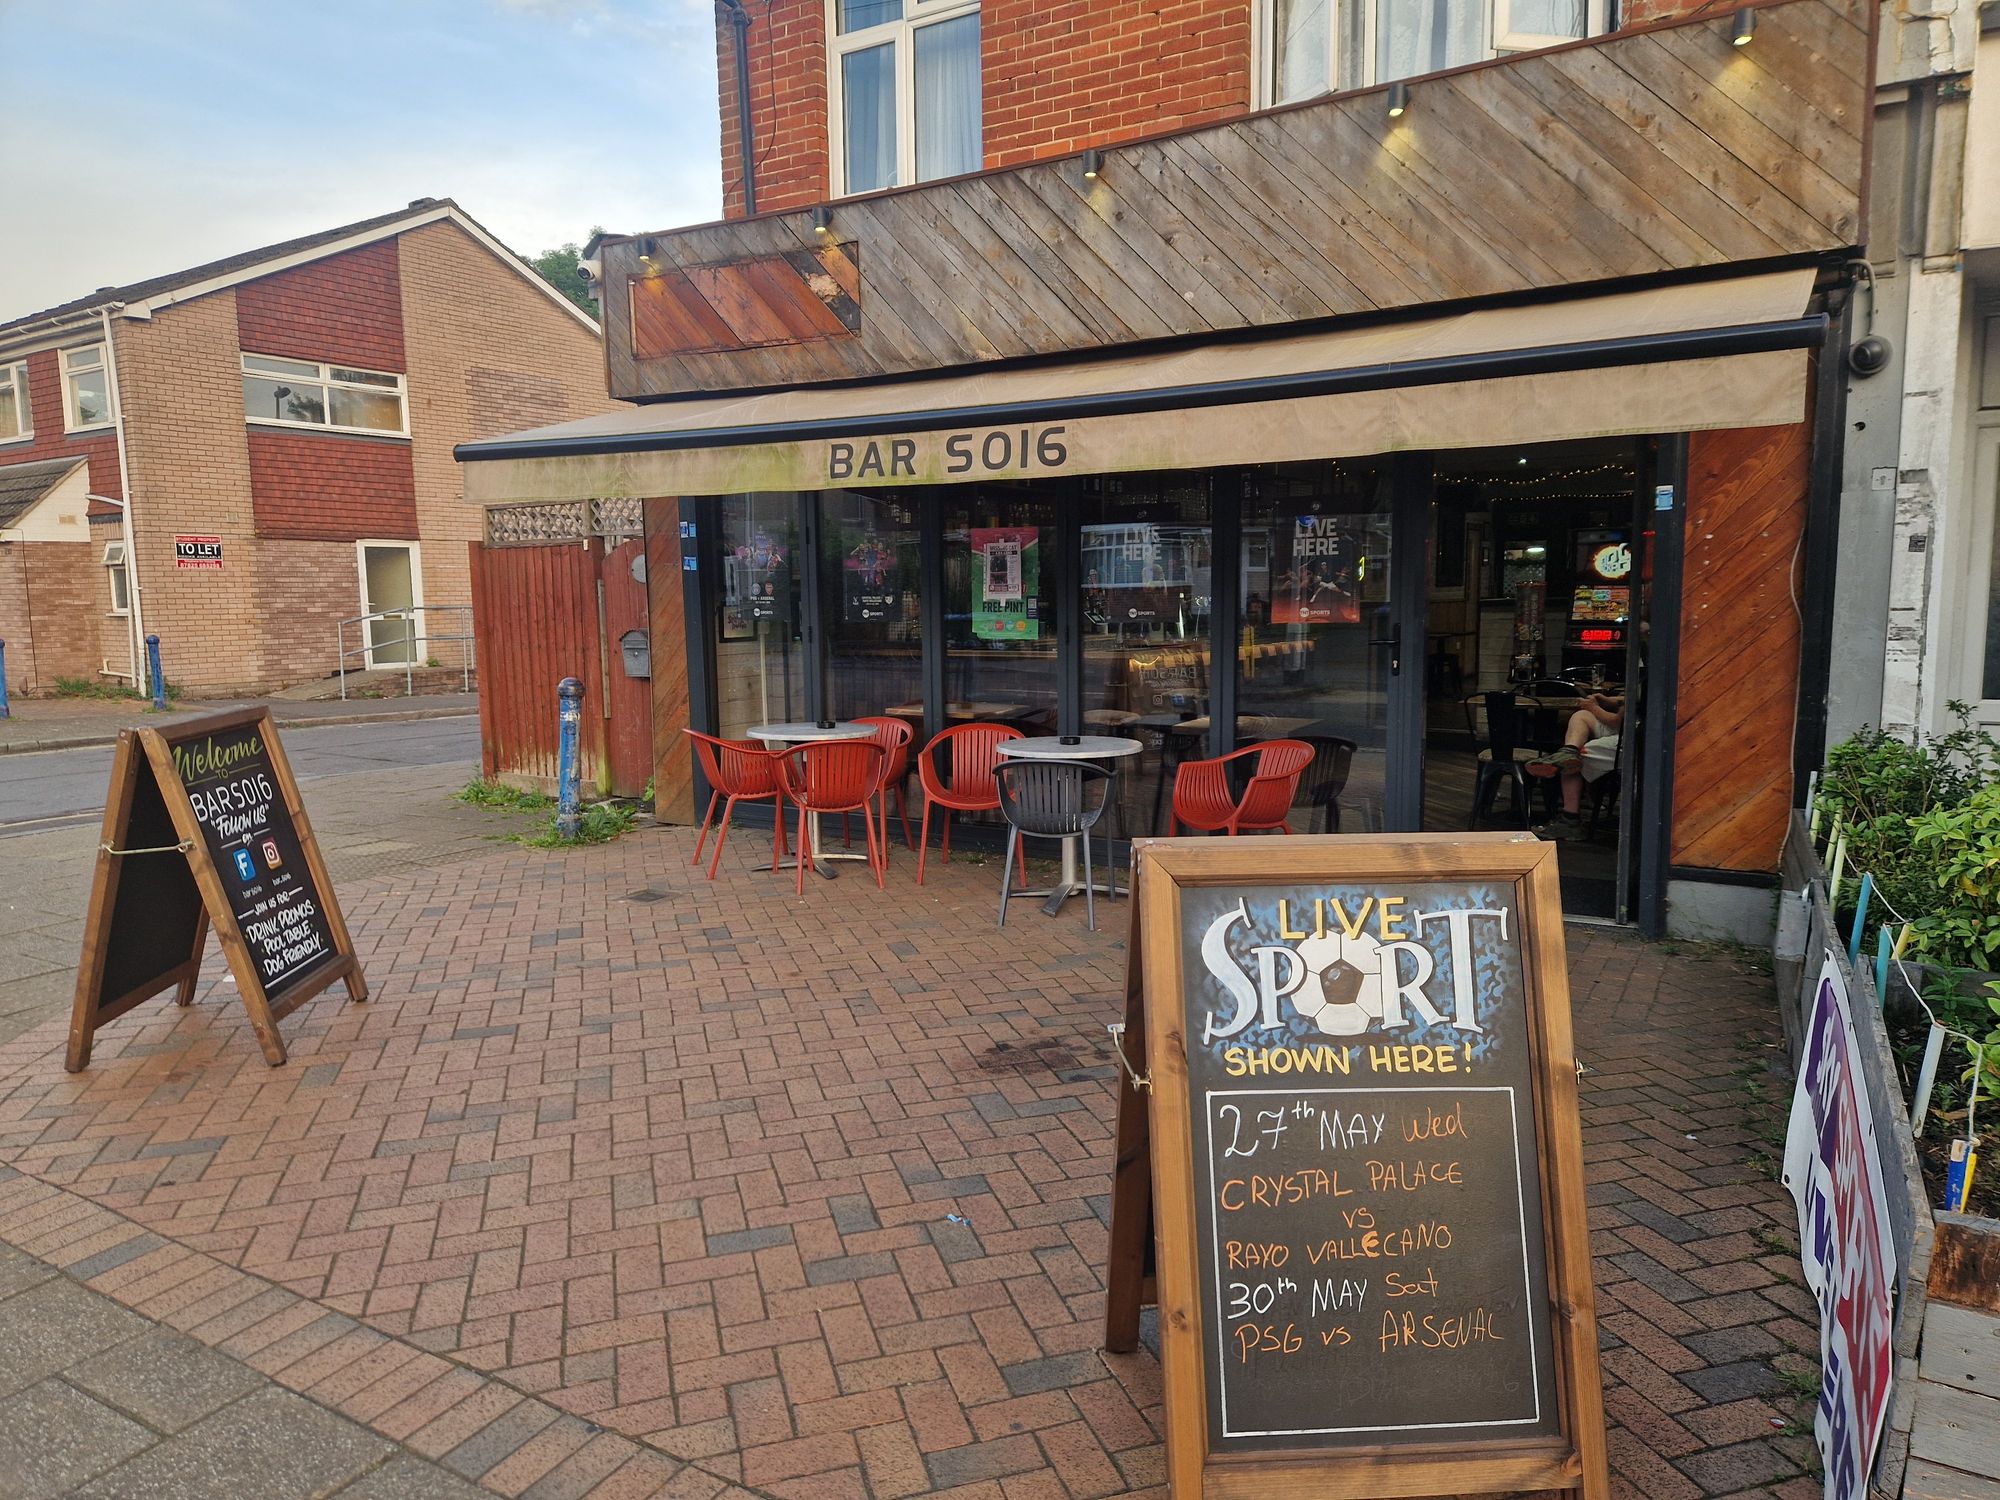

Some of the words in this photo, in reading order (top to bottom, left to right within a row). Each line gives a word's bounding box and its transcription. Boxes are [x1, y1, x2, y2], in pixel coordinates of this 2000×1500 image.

[830, 438, 916, 480] BAR
[1293, 537, 1340, 557] HERE
[1295, 517, 1338, 538] LIVE
[178, 543, 195, 555] TO
[197, 544, 219, 555] LET
[1122, 544, 1163, 560] HERE
[1004, 602, 1025, 613] PINT
[173, 736, 264, 781] Welcome
[215, 768, 229, 778] TO
[247, 916, 280, 944] DRINK
[277, 899, 315, 928] PROMOS
[254, 900, 269, 916] JOIN
[276, 891, 290, 905] FOR
[1279, 896, 1407, 941] LIVE
[264, 936, 286, 956] POOL
[283, 920, 311, 945] TABLE
[264, 954, 285, 977] DOG
[282, 931, 322, 966] FRIENDLY
[1224, 1045, 1350, 1077] SHOWN
[1219, 1099, 1315, 1158] 27th
[1320, 1109, 1386, 1151] MAY
[1401, 1102, 1468, 1143] Wed
[1220, 1168, 1353, 1211] CRYSTAL
[1365, 1160, 1463, 1192] PALACE
[1226, 1240, 1289, 1270] RAYO
[1306, 1221, 1452, 1265] VALLECANO
[1227, 1277, 1297, 1319] 30th
[1311, 1278, 1368, 1317] MAY
[1385, 1268, 1439, 1298] Sat
[1235, 1323, 1303, 1364] PSG
[1378, 1307, 1504, 1353] ARSENAL
